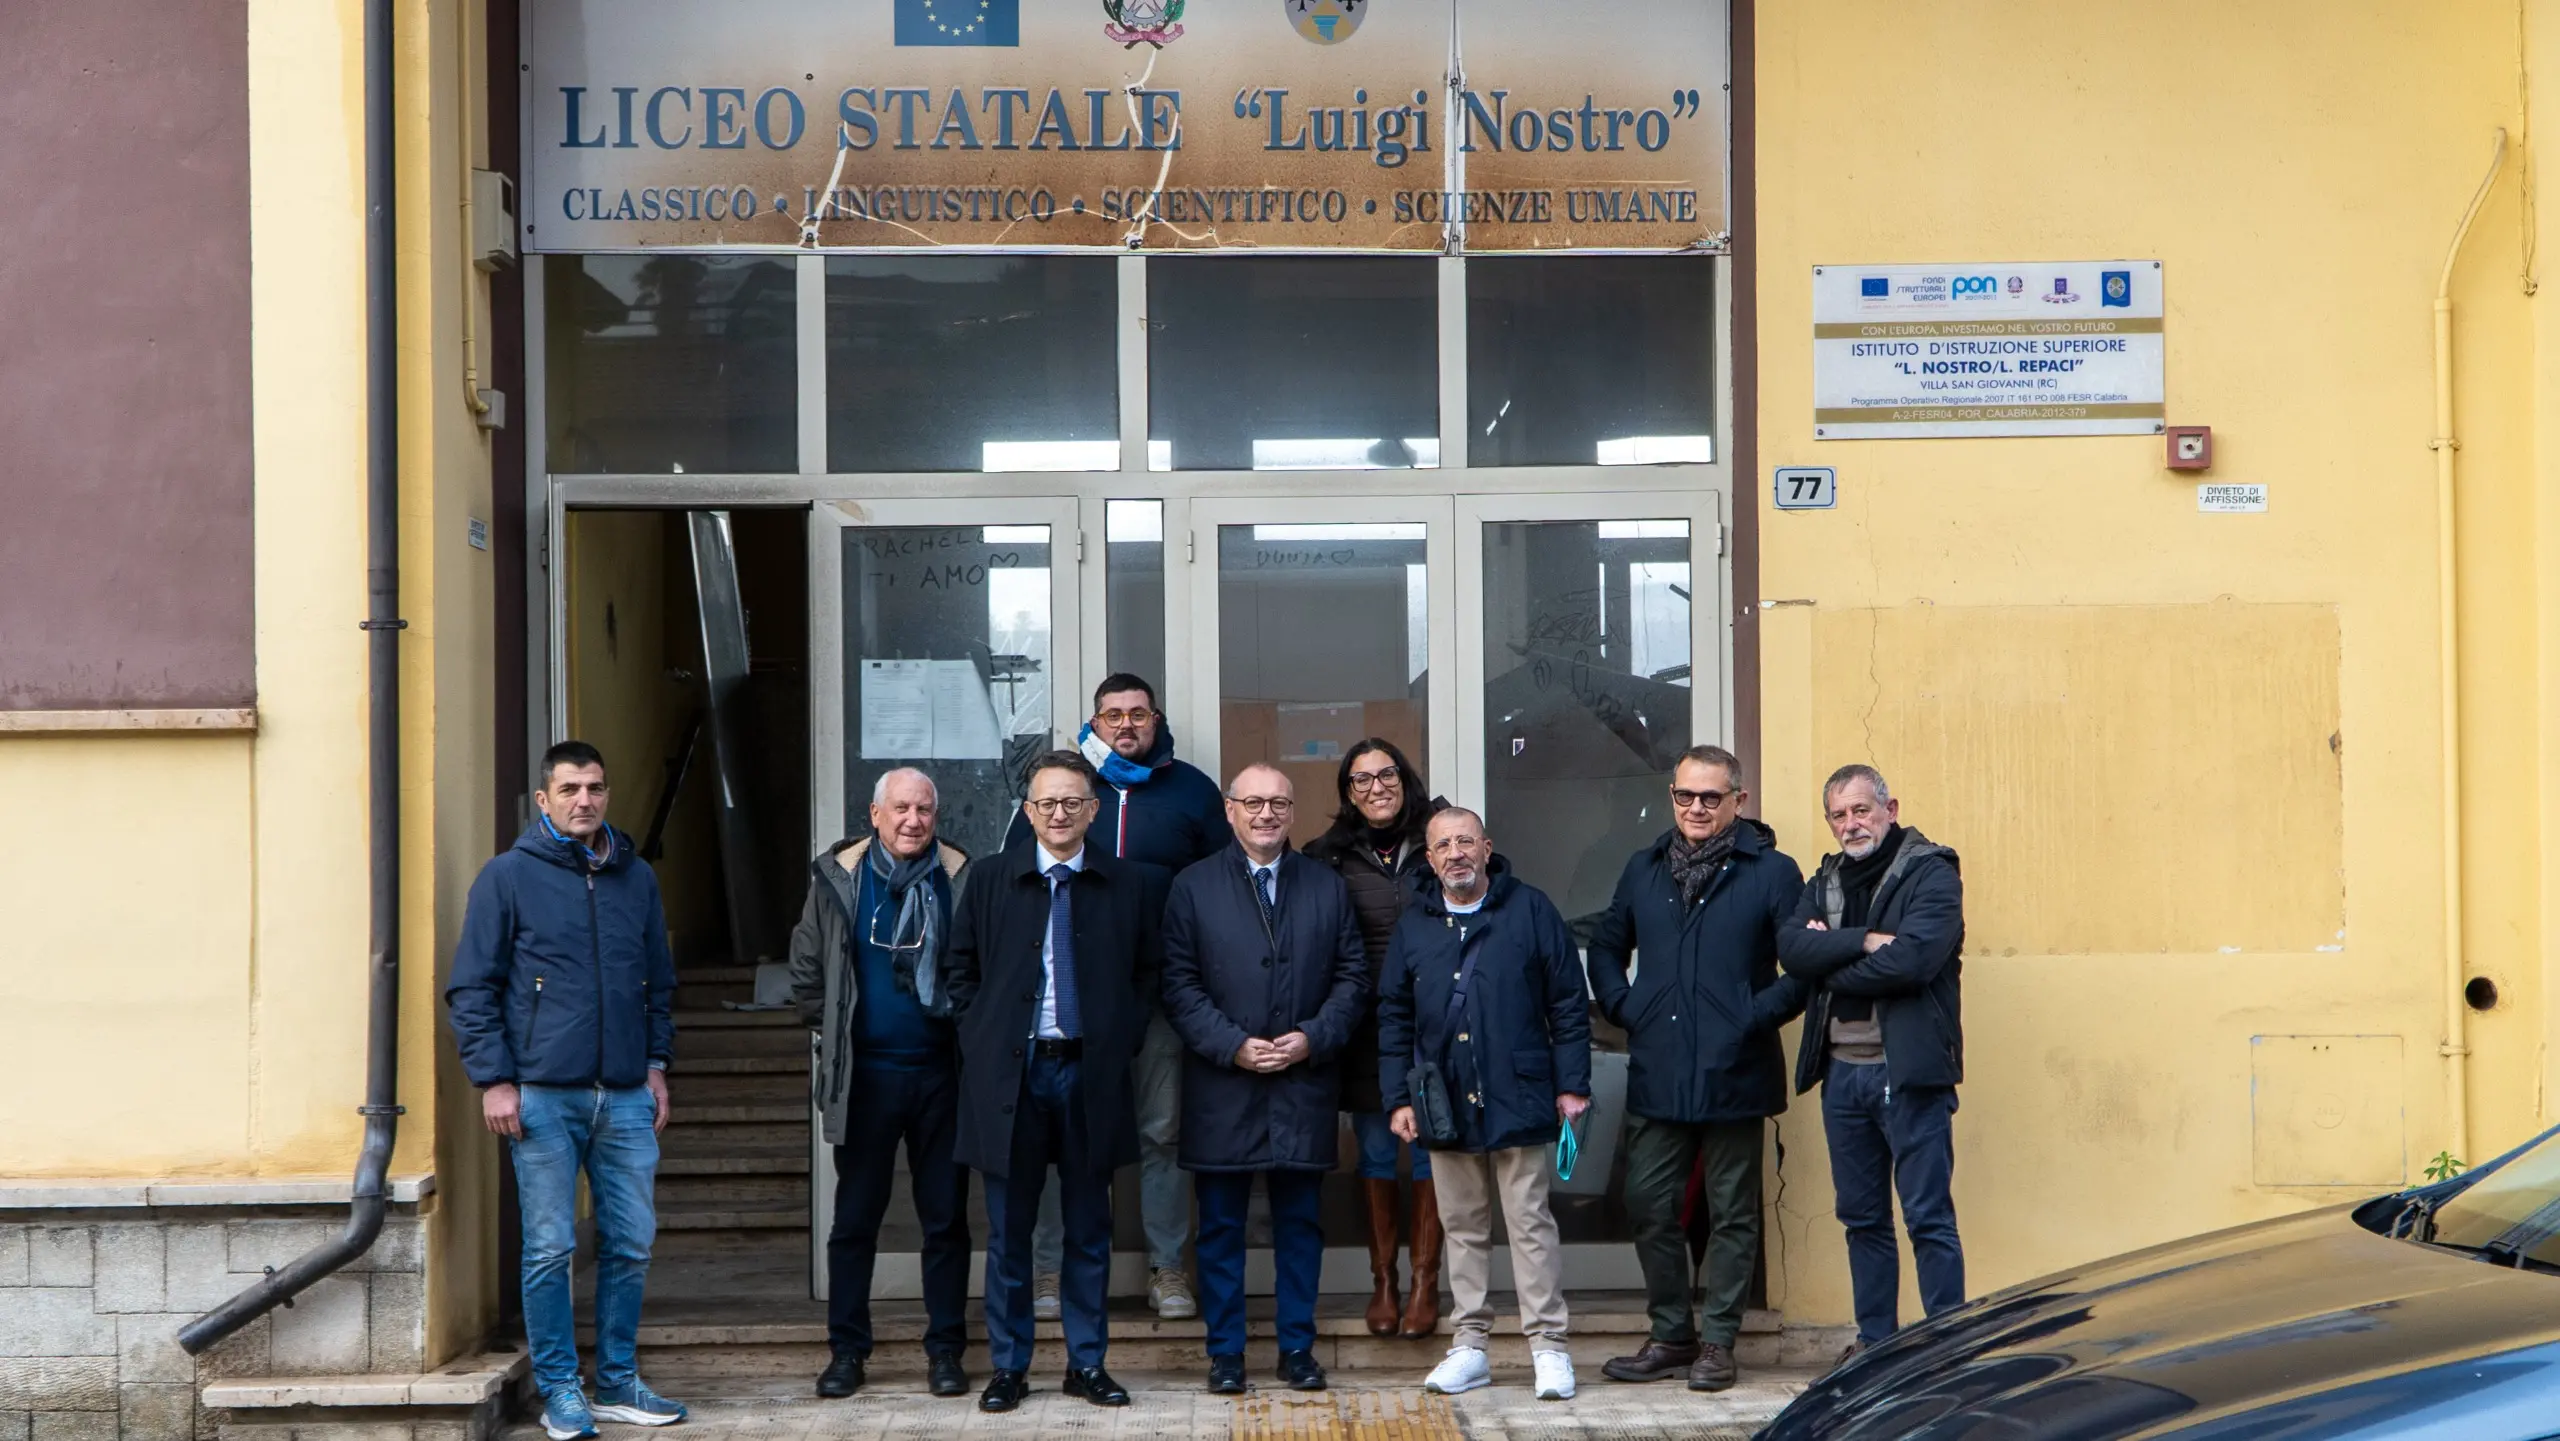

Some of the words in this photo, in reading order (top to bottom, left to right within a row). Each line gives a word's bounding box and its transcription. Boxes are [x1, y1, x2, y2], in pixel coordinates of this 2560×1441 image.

[559, 86, 805, 150] LICEO
[838, 87, 1182, 150] STATALE
[1233, 88, 1431, 168] “Luigi
[1459, 88, 1700, 152] Nostro”
[563, 187, 757, 221] CLASSICO
[803, 186, 1056, 222] LINGUISTICO
[1102, 186, 1347, 222] SCIENTIFICO
[1394, 190, 1552, 224] SCIENZE
[1566, 190, 1697, 224] UMANE
[1952, 276, 1998, 300] pon
[1912, 294, 1946, 302] EUROPEI
[1861, 326, 1887, 336] CON
[1942, 324, 2004, 335] INVESTIAMO
[2008, 323, 2027, 333] NEL
[2029, 322, 2072, 333] VOSTRO
[2074, 321, 2116, 332] FUTURO
[1851, 342, 1919, 356] ISTITUTO
[1930, 340, 2038, 355] D'ISTRUZIONE
[2043, 339, 2127, 354] SUPERIORE
[1922, 360, 2014, 374] NOSTRO/L.
[1920, 380, 1949, 390] VILLA
[1951, 380, 1974, 389] SAN
[1977, 379, 2034, 389] GIOVANNI
[2037, 378, 2058, 390] (RC)
[1851, 397, 1898, 407] Programma
[1900, 396, 1940, 406] Operativo
[1942, 395, 1982, 405] Regionale
[1984, 394, 2004, 403] 2007
[2035, 394, 2048, 402] PO
[2067, 393, 2092, 402] FESR
[2094, 393, 2127, 401] Calabria
[1788, 477, 1822, 500] 77
[2207, 487, 2245, 496] DIVIETO
[2249, 487, 2259, 496] DI
[2204, 496, 2262, 504] AFFISSIONE
[919, 563, 985, 590] AMO
